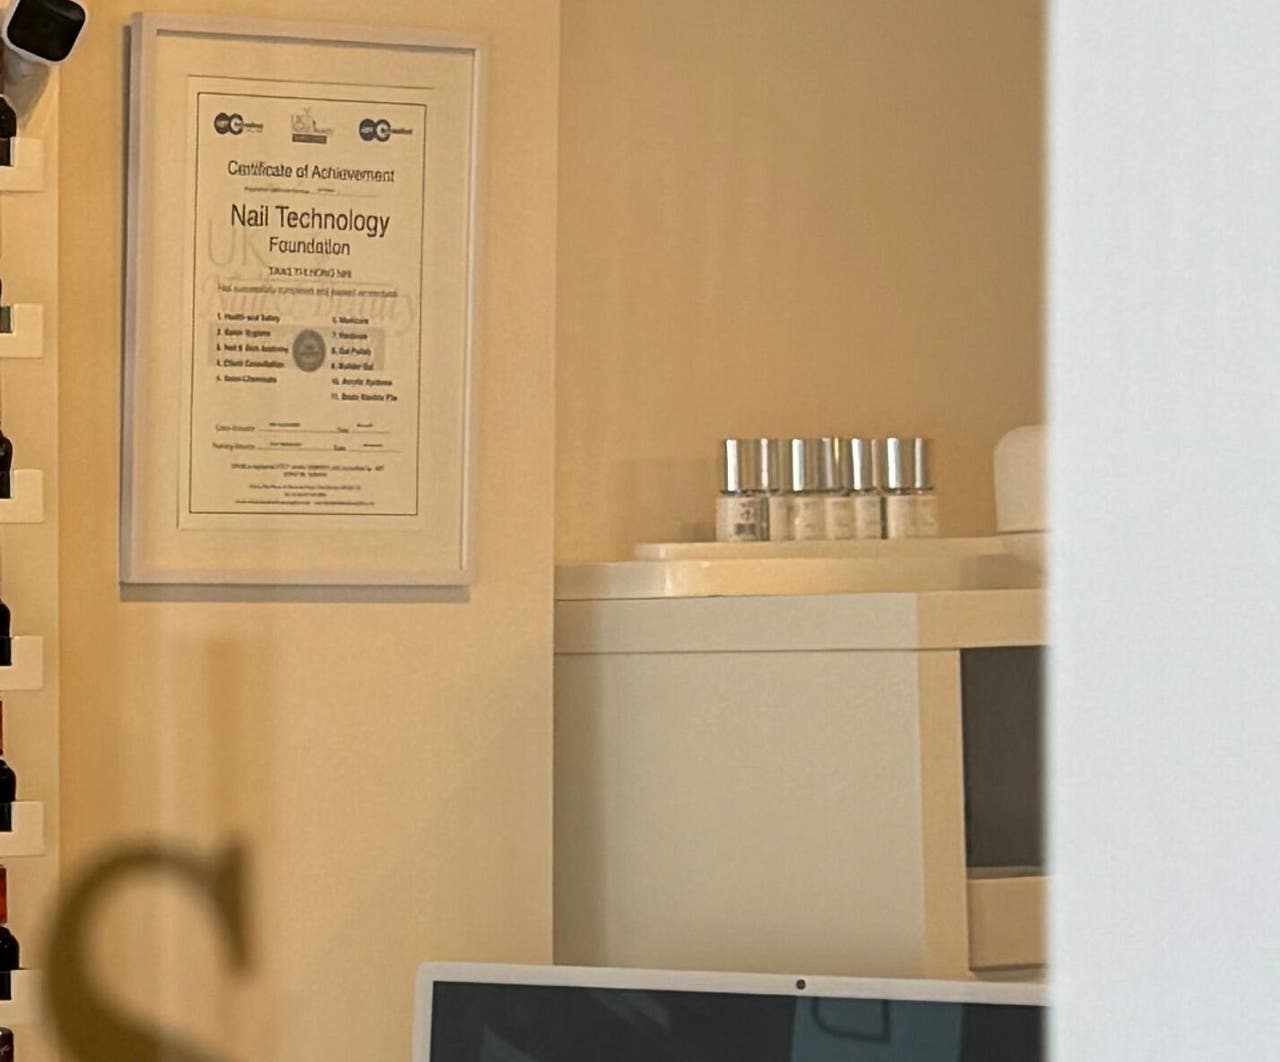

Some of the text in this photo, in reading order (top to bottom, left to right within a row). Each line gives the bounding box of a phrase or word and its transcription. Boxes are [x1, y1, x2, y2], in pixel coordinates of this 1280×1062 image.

[228, 160, 395, 183] Certificate of Achievement
[231, 203, 391, 238] Nail Technology
[269, 236, 351, 256] Foundation
